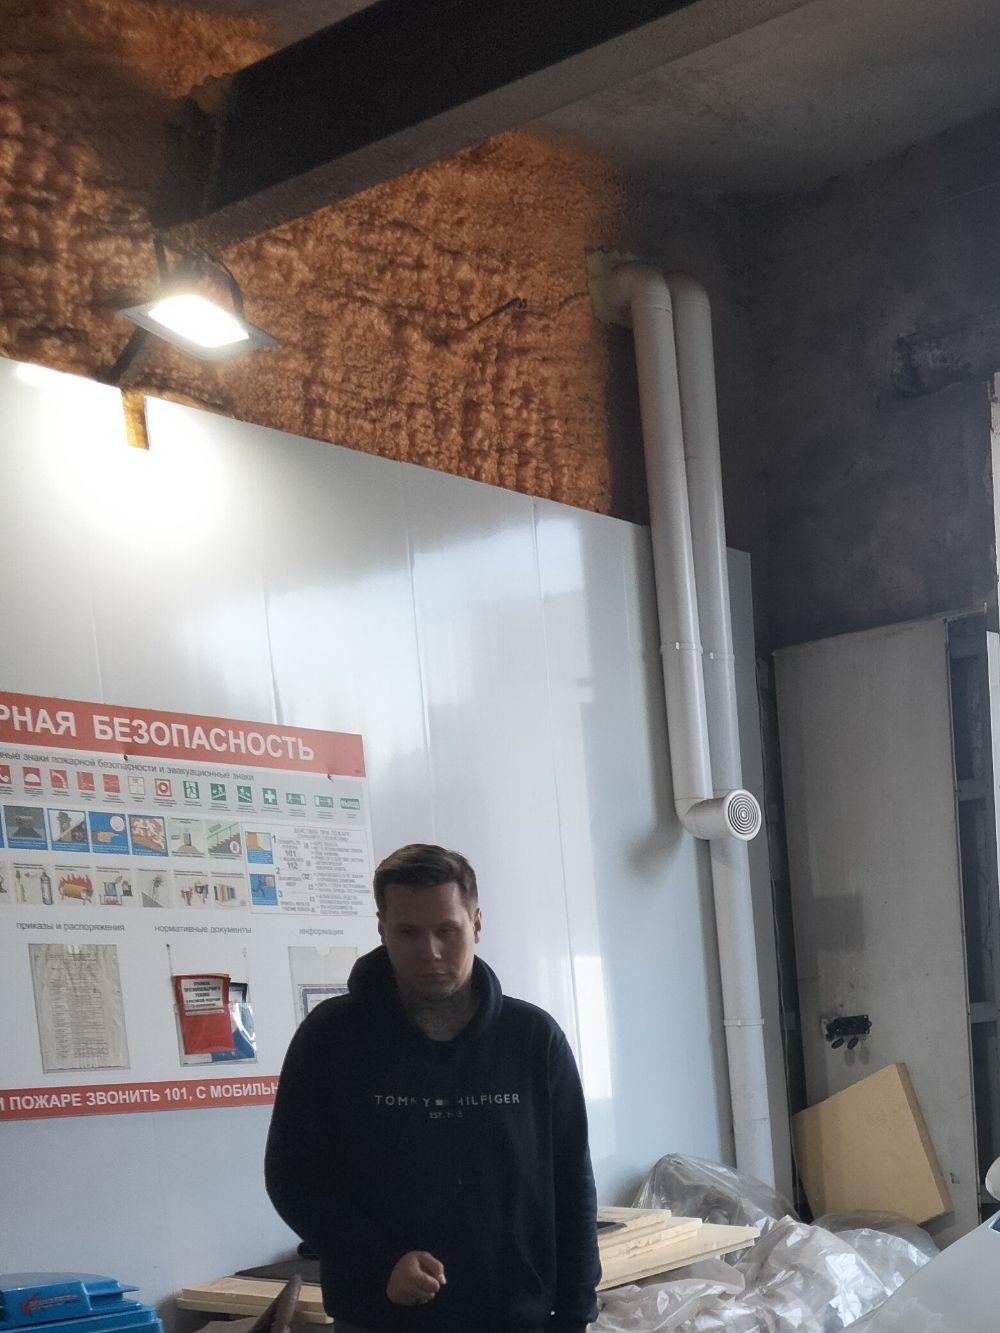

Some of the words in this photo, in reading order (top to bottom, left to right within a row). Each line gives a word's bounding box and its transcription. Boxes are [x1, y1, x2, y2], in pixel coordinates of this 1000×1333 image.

[92, 714, 314, 761] БЕЗОПАСНОСТЬ
[23, 754, 50, 764] знаки
[51, 755, 96, 769] пожарной
[97, 758, 157, 774] безопасности
[159, 766, 165, 774] и
[16, 922, 54, 931] приказы
[64, 923, 125, 932] распоряжения
[154, 925, 209, 934] нормативные
[210, 926, 252, 934] документы
[9, 1093, 82, 1111] ПОЖАРЕ
[86, 1089, 160, 1107] ЗВОНИТЬ
[164, 1086, 192, 1102] 101,
[196, 1085, 206, 1100] С
